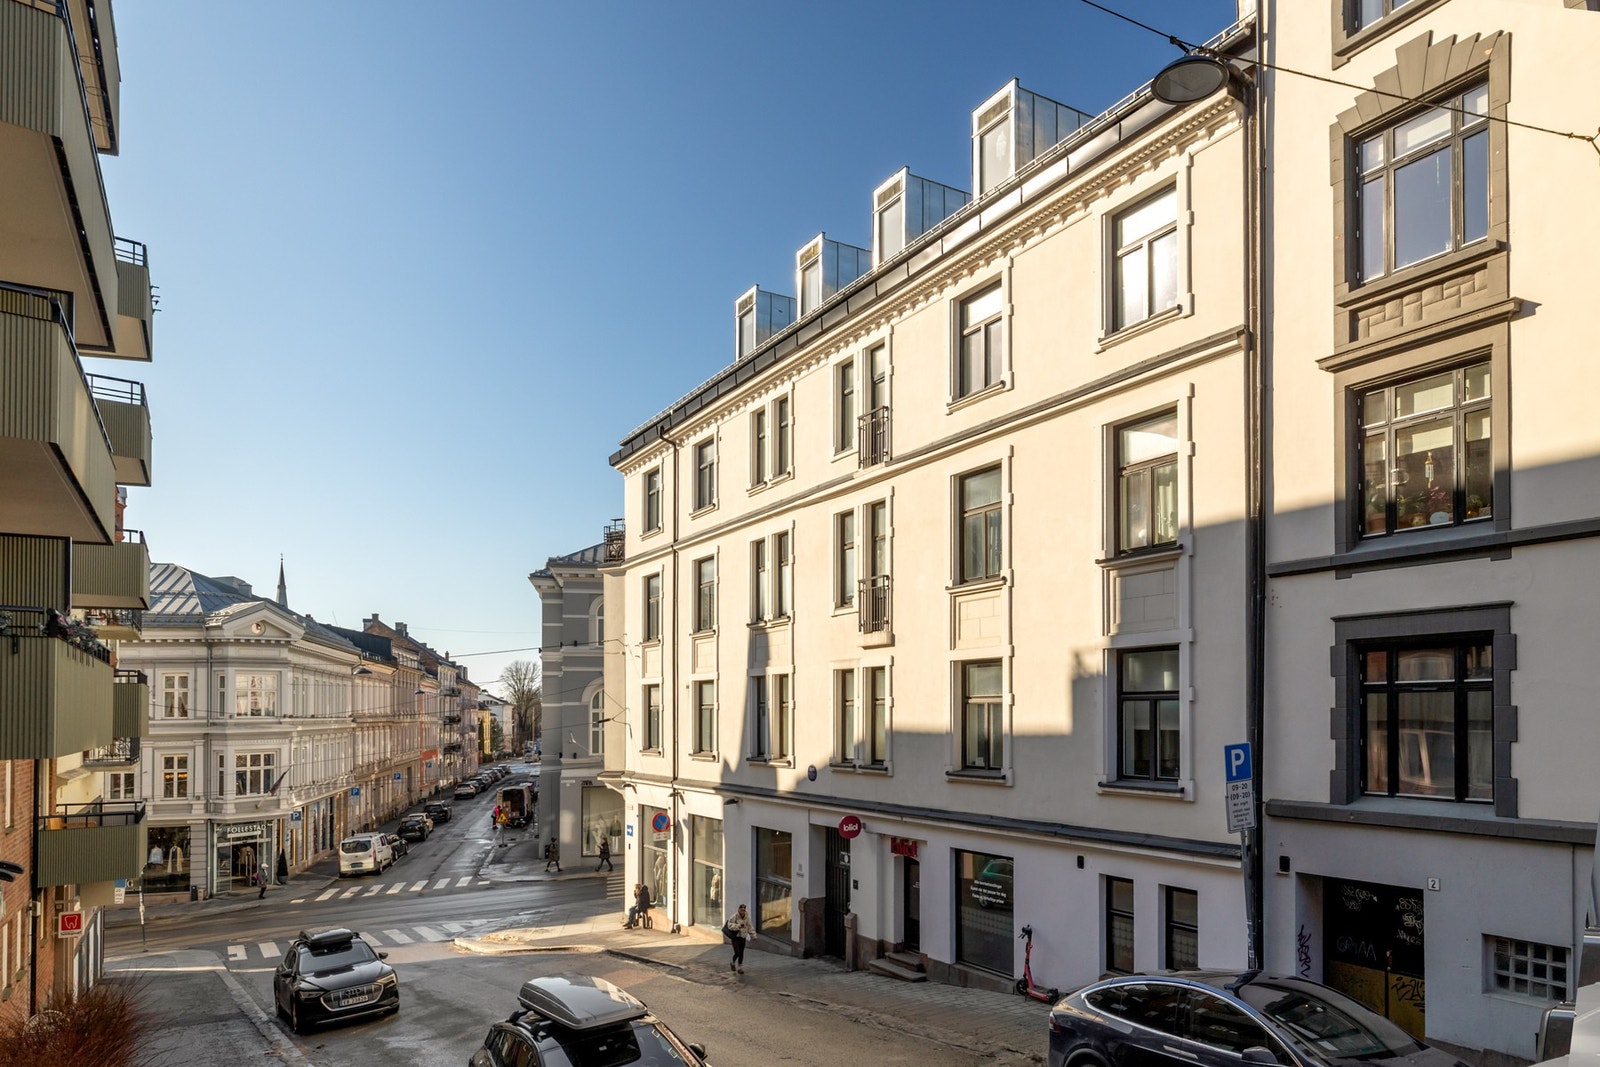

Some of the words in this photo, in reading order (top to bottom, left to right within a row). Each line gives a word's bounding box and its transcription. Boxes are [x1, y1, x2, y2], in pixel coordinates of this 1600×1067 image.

[1231, 749, 1245, 777] P
[293, 812, 299, 820] P
[227, 824, 267, 833] FOLLESTAD
[843, 823, 858, 832] blid
[891, 837, 917, 857] blid
[1431, 880, 1436, 888] 2
